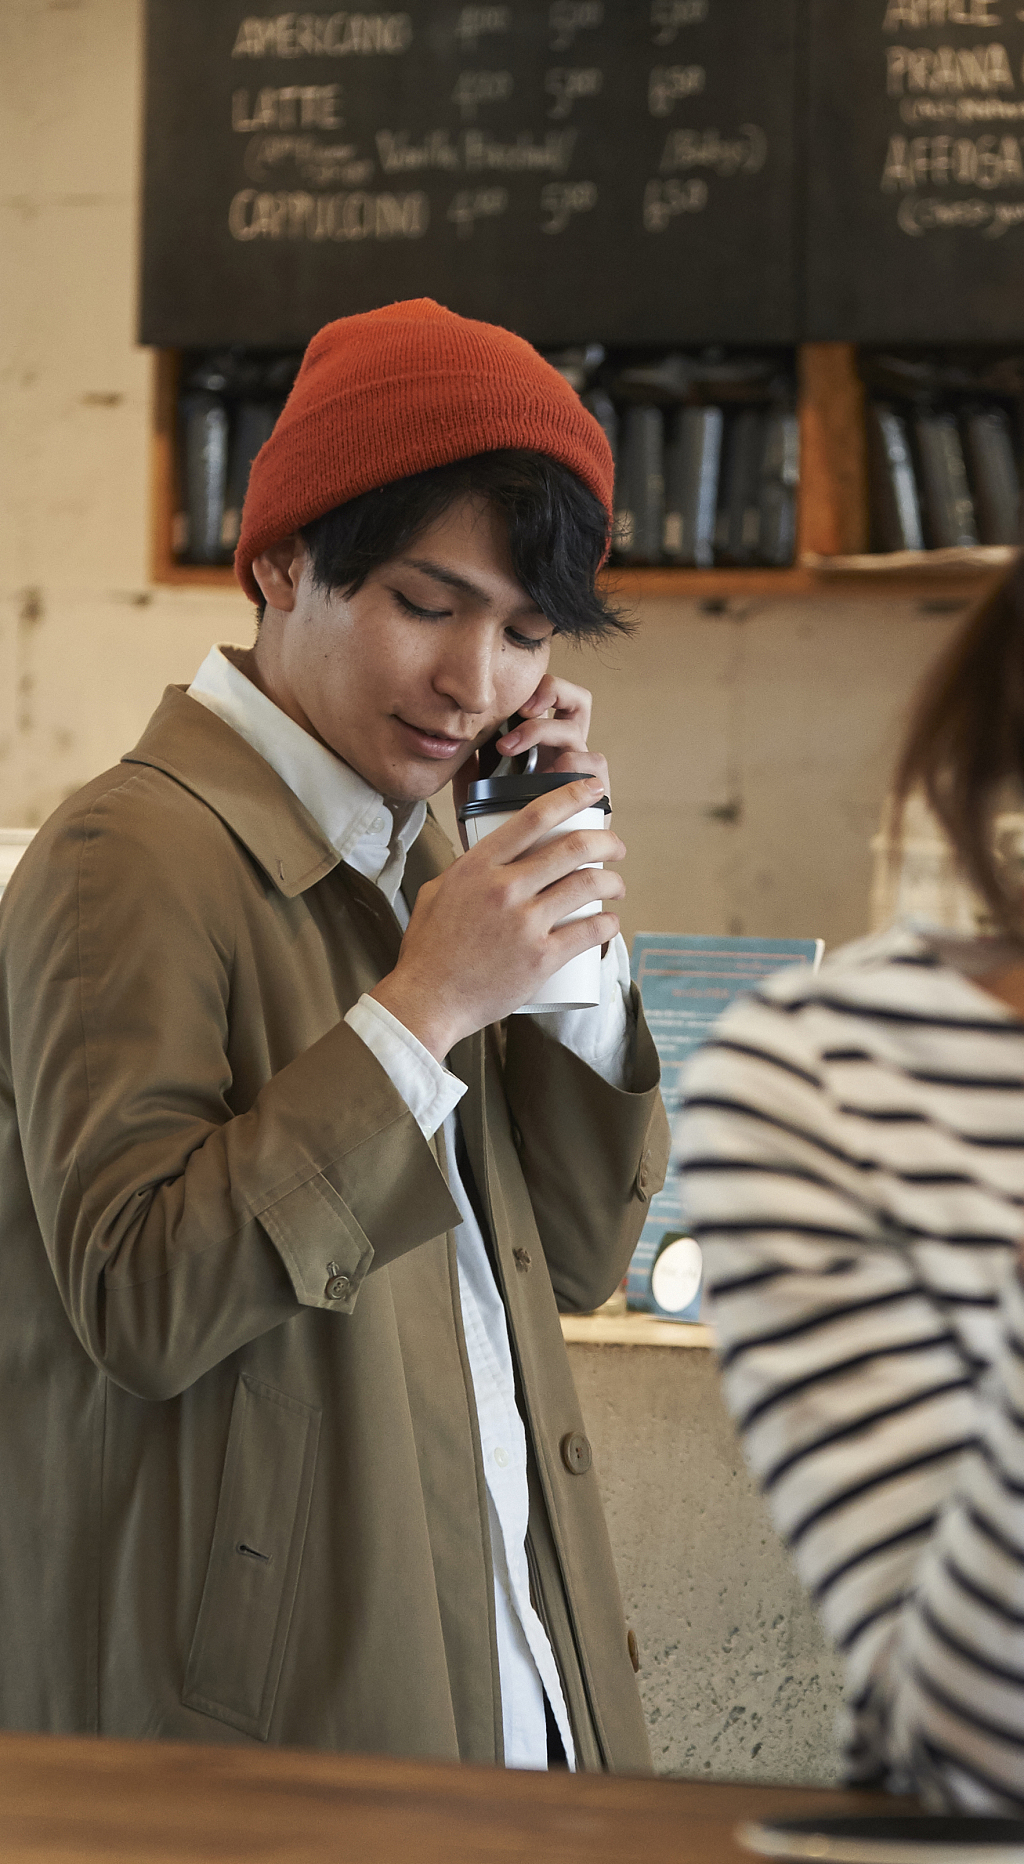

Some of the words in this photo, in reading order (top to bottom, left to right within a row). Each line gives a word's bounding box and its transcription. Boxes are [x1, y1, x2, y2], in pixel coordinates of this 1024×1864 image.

[232, 12, 413, 59] AMERICANO
[231, 83, 346, 132] LATTE
[228, 189, 430, 241] CAPPUCCINO
